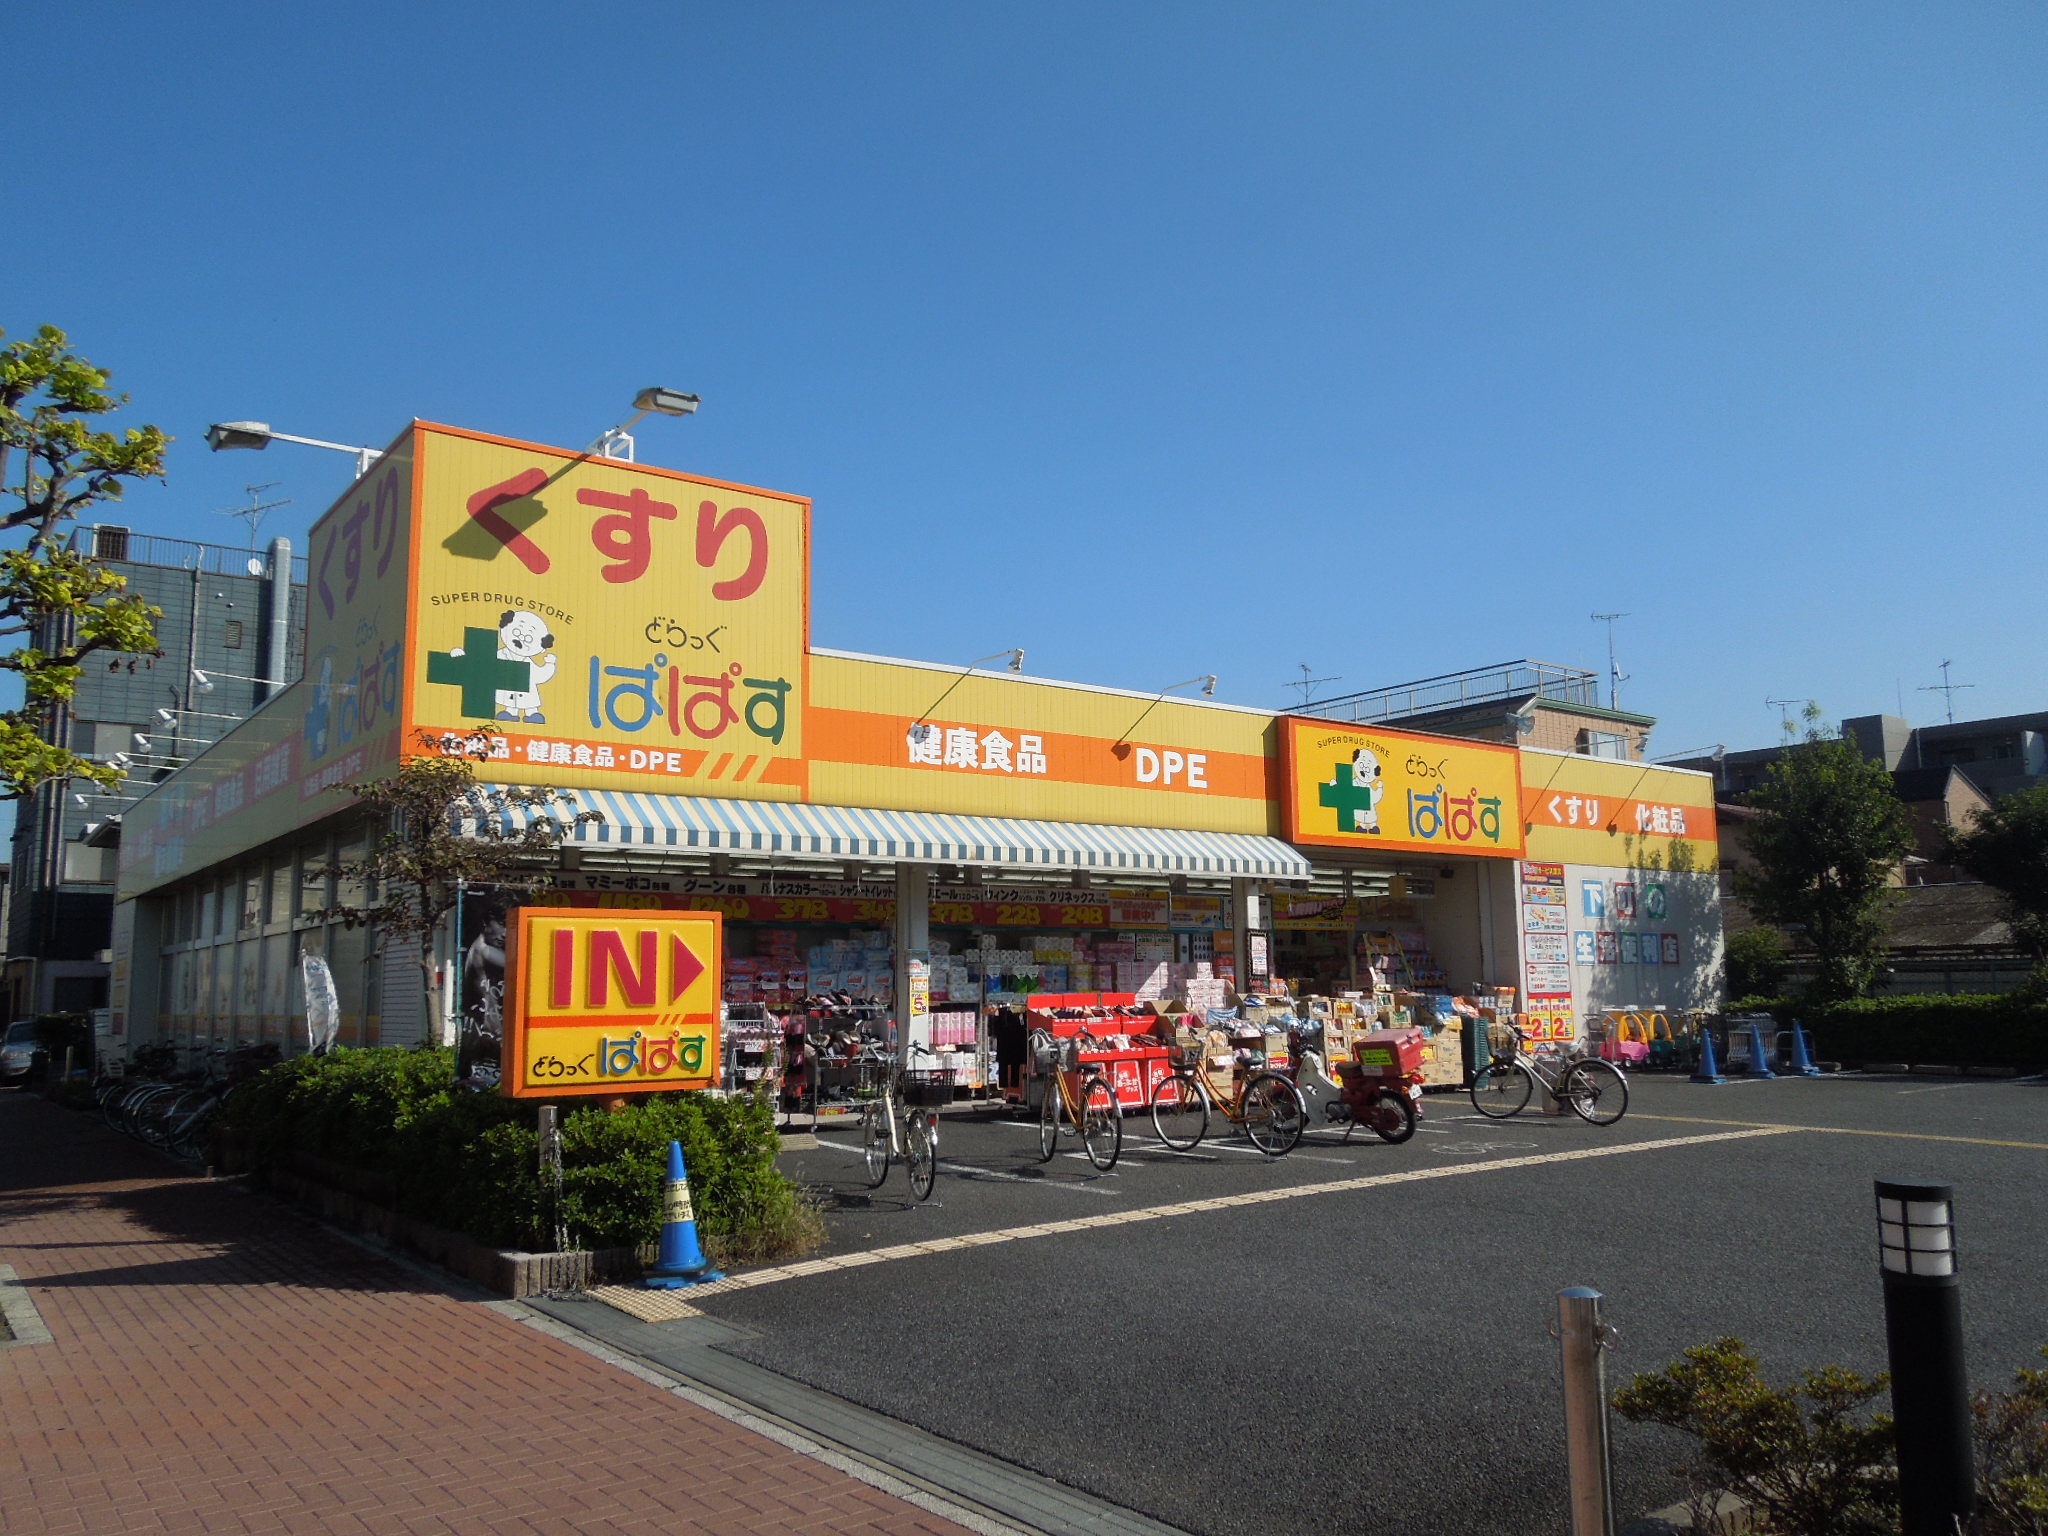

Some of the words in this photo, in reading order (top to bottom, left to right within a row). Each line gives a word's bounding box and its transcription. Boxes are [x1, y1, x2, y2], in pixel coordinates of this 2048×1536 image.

[318, 466, 398, 620] くすり
[466, 467, 768, 600] くすり
[431, 592, 480, 606] SUPER
[483, 592, 524, 607] DRUG
[528, 599, 574, 625] STORE
[588, 653, 792, 745] ぱぱす
[906, 722, 1046, 773] 健康食品
[1317, 736, 1342, 748] SUPER
[1343, 735, 1364, 746] DRUG
[1366, 740, 1390, 758] STORE
[1136, 747, 1208, 788] DPE
[1407, 783, 1501, 843] ぱぱす
[1548, 795, 1598, 826] くすり
[1635, 803, 1686, 834] 化粧品
[684, 878, 725, 893] グーン
[1050, 889, 1095, 904] クリネックス
[1583, 883, 1664, 914] 下町の
[774, 898, 829, 919] 378
[928, 903, 974, 923] 378
[995, 904, 1041, 925] 228
[1061, 905, 1103, 925] 298
[1576, 934, 1677, 962] 生活便利店
[551, 929, 658, 1007] IN
[1531, 1018, 1543, 1037] 2
[1554, 1017, 1565, 1037] 2
[601, 1029, 707, 1076] ぱぱす
